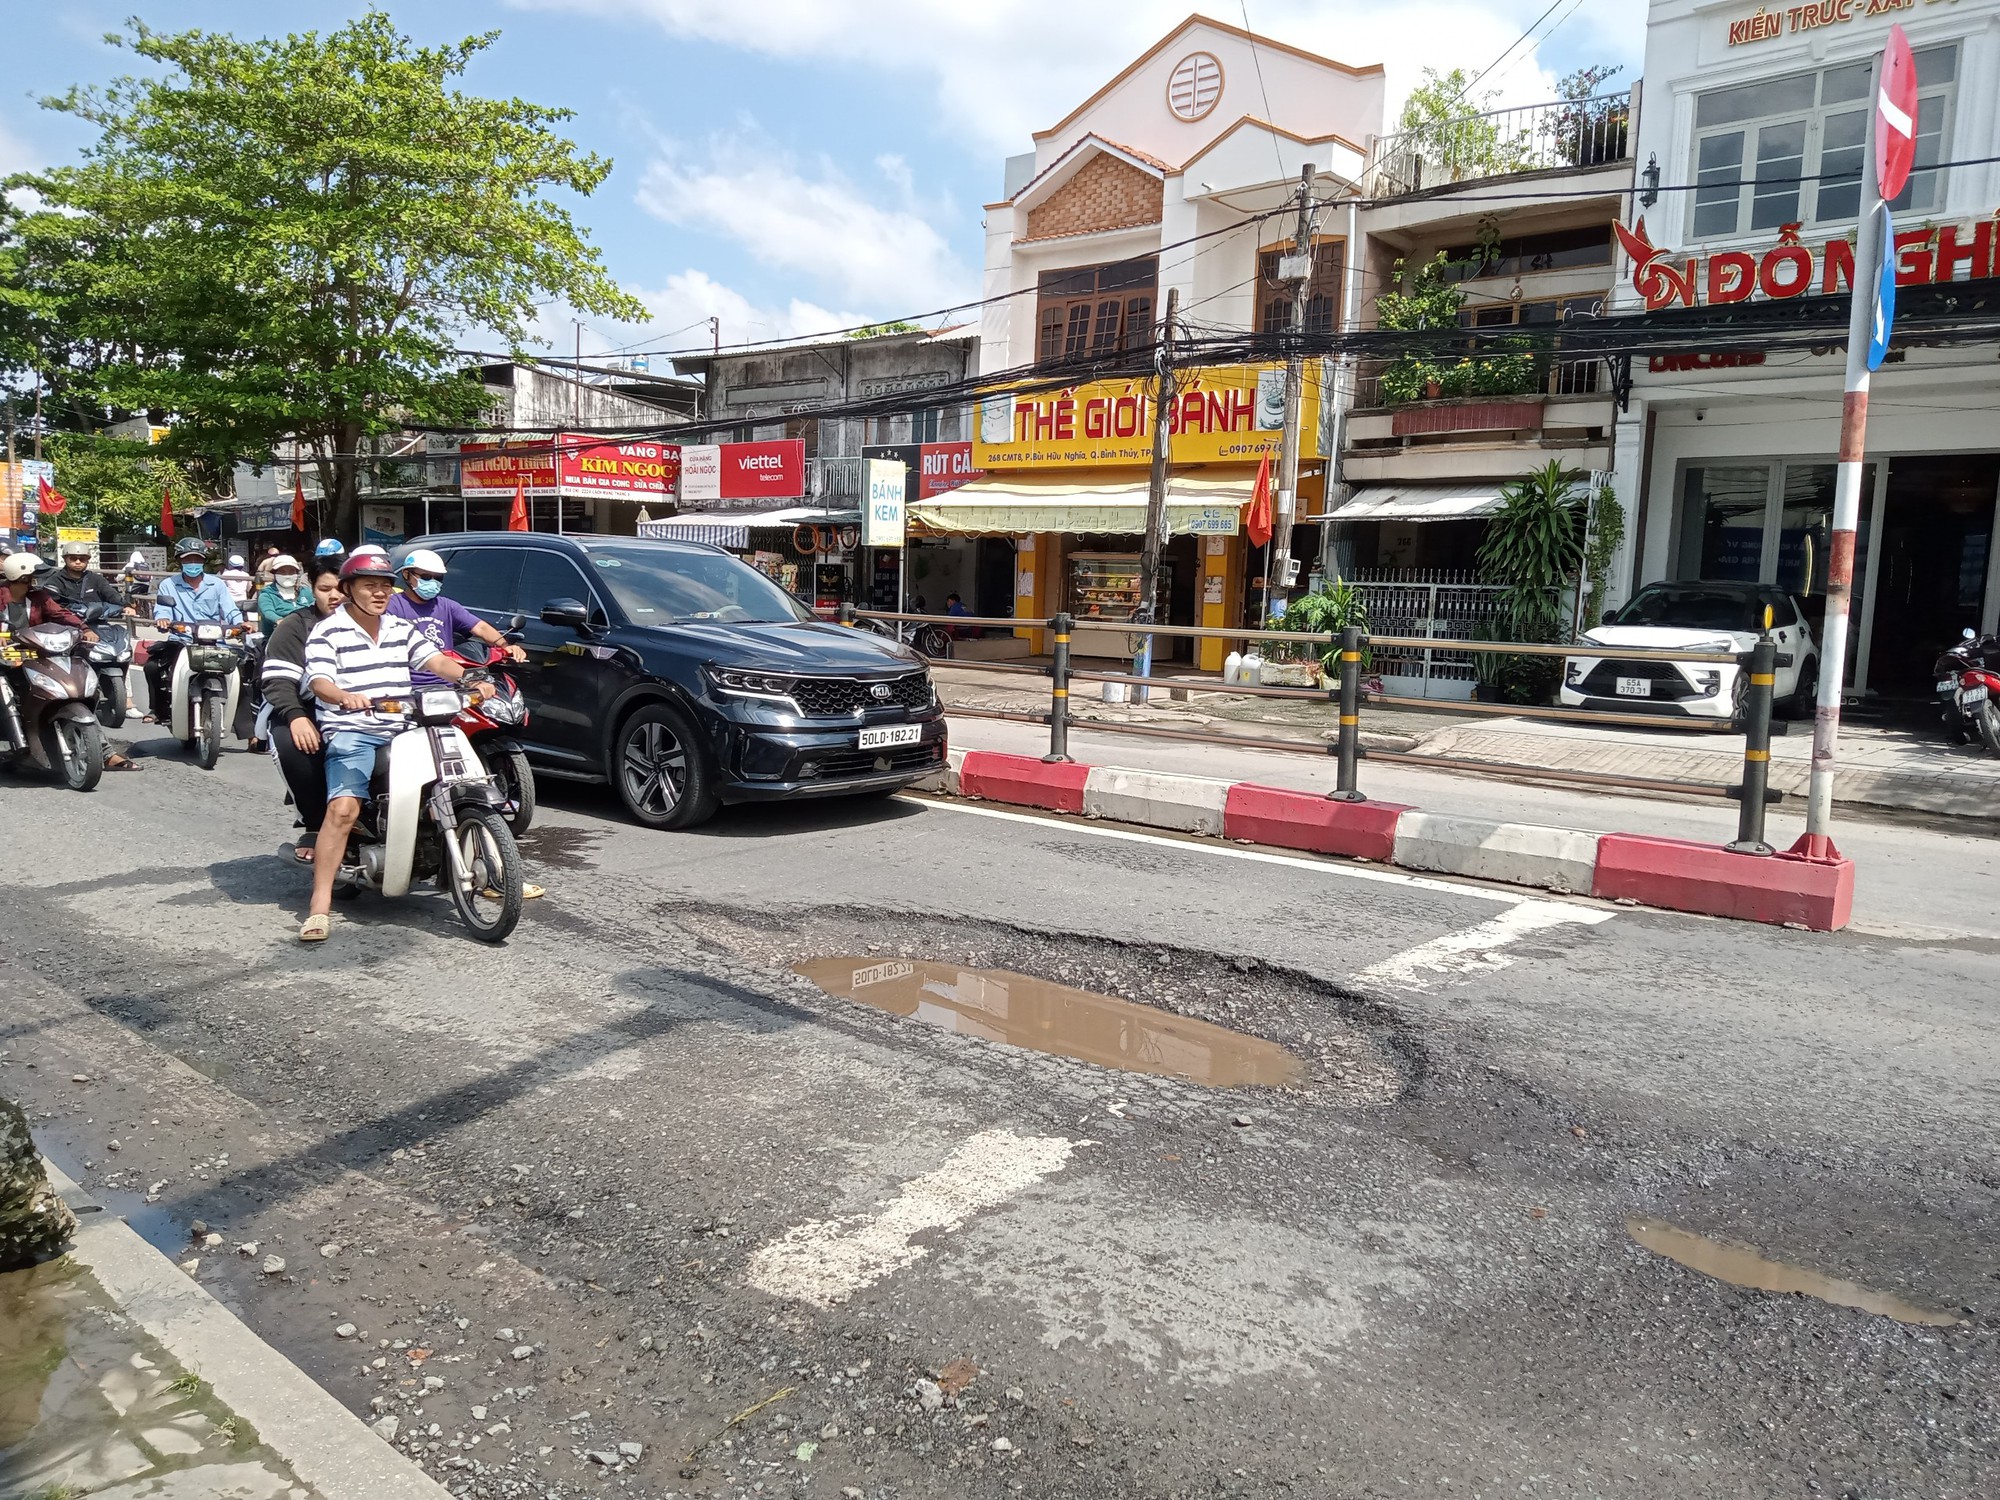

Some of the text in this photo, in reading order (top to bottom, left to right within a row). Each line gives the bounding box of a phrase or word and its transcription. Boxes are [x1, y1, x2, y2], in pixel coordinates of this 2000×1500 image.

[1727, 6, 1782, 45] KIẾN
[1706, 222, 1814, 306] ĐỖ
[1015, 380, 1257, 442] THẾ GIỚI BÁNH
[988, 454, 1001, 463] 268
[1002, 452, 1024, 463] CMT8,
[1046, 449, 1062, 461] Hữu
[1119, 447, 1140, 460] Thủy,
[1229, 444, 1253, 454] 0907
[739, 454, 783, 470] viettel
[923, 450, 949, 476] RÚT
[565, 476, 581, 484] MUA
[582, 476, 597, 486] BÁN
[598, 478, 611, 487] GIA
[760, 474, 783, 482] telecom
[872, 480, 902, 500] BÁNH
[875, 505, 897, 521] KEM
[1191, 520, 1232, 529] 0907 699 685
[875, 687, 890, 697] KIA
[1620, 686, 1646, 694] 370.31
